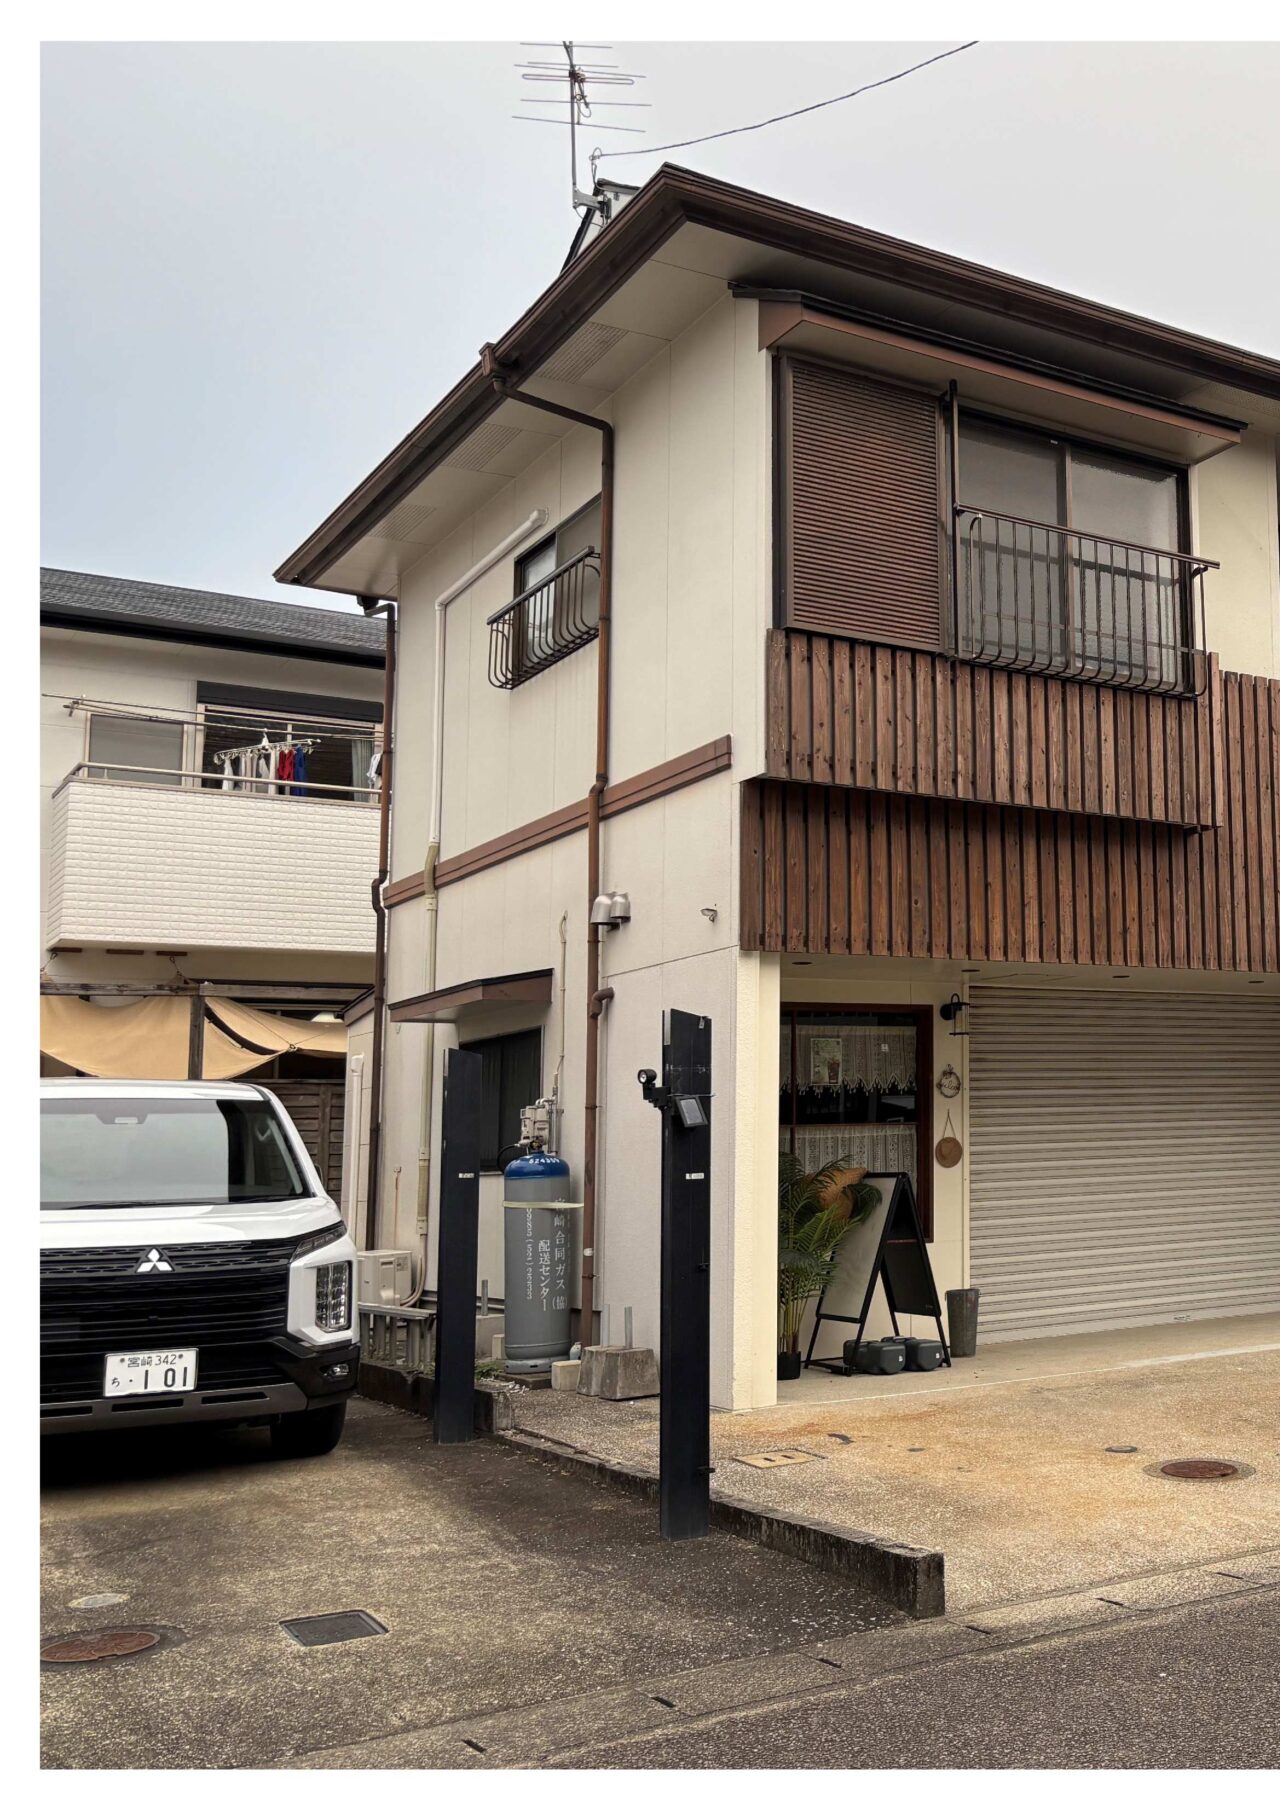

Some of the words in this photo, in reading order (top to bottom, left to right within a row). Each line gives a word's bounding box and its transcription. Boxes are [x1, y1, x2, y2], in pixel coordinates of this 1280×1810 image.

[538, 1239, 551, 1312] 配送センター
